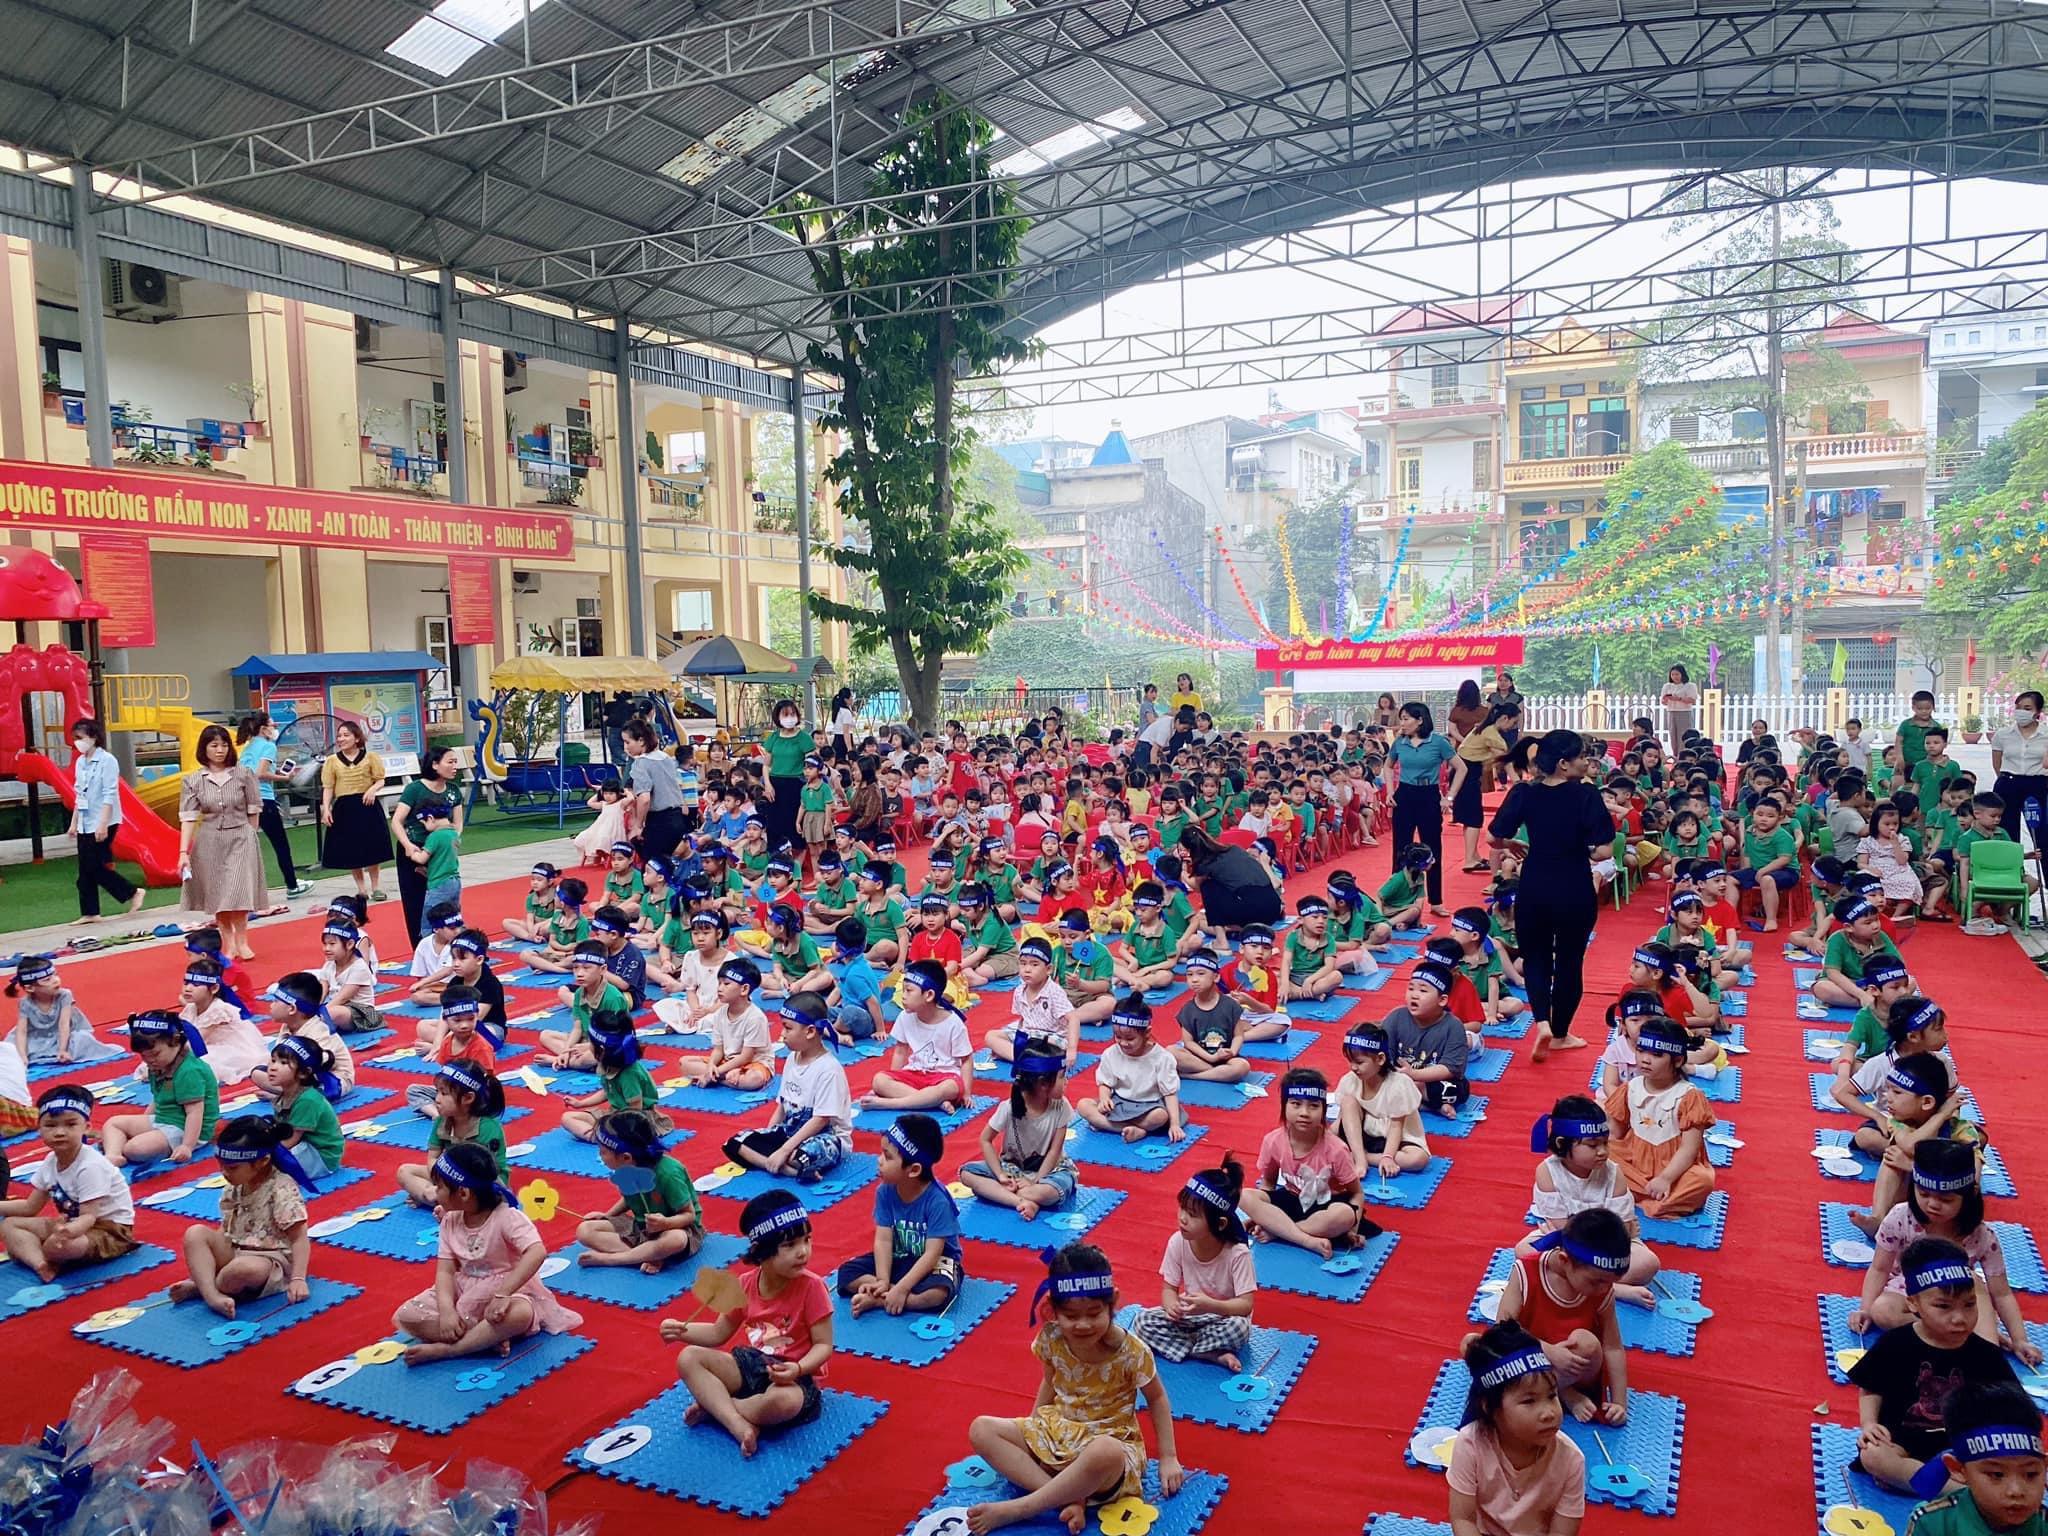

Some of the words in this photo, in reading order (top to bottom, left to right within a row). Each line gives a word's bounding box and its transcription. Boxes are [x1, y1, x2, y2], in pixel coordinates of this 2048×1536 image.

[62, 485, 149, 522] TRƯỜNG
[154, 489, 204, 527] MẦM
[209, 502, 249, 529] NON
[266, 506, 312, 534] XANH
[350, 510, 390, 539] TOÀN
[404, 516, 442, 543] THÂN
[445, 519, 483, 550] THIỆN
[494, 522, 524, 548] BÌNH
[1305, 650, 1323, 661] em
[1327, 646, 1354, 660] hôm
[1358, 648, 1382, 663] nay
[1384, 642, 1410, 659] thế
[1407, 643, 1434, 662] giới
[1437, 642, 1471, 662] ngày
[1470, 642, 1498, 657] mai
[1080, 947, 1089, 957] B
[1876, 969, 1903, 981] DOLPHIN
[284, 1038, 310, 1060] ENGLISH
[1351, 1036, 1379, 1049] ENGLISH
[1654, 1038, 1682, 1053] ENGLISH
[453, 1071, 481, 1091] ENGLISH
[890, 1129, 919, 1156] ENGLISH
[220, 1149, 257, 1160] ENGLISH
[1196, 1183, 1231, 1210] ENGLISH
[1057, 1277, 1101, 1293] DOLPHIN
[1916, 1265, 1966, 1287] DOLPHIN
[1480, 1357, 1527, 1389] DOLPHIN
[1966, 1433, 2030, 1455] DOLPHIN
